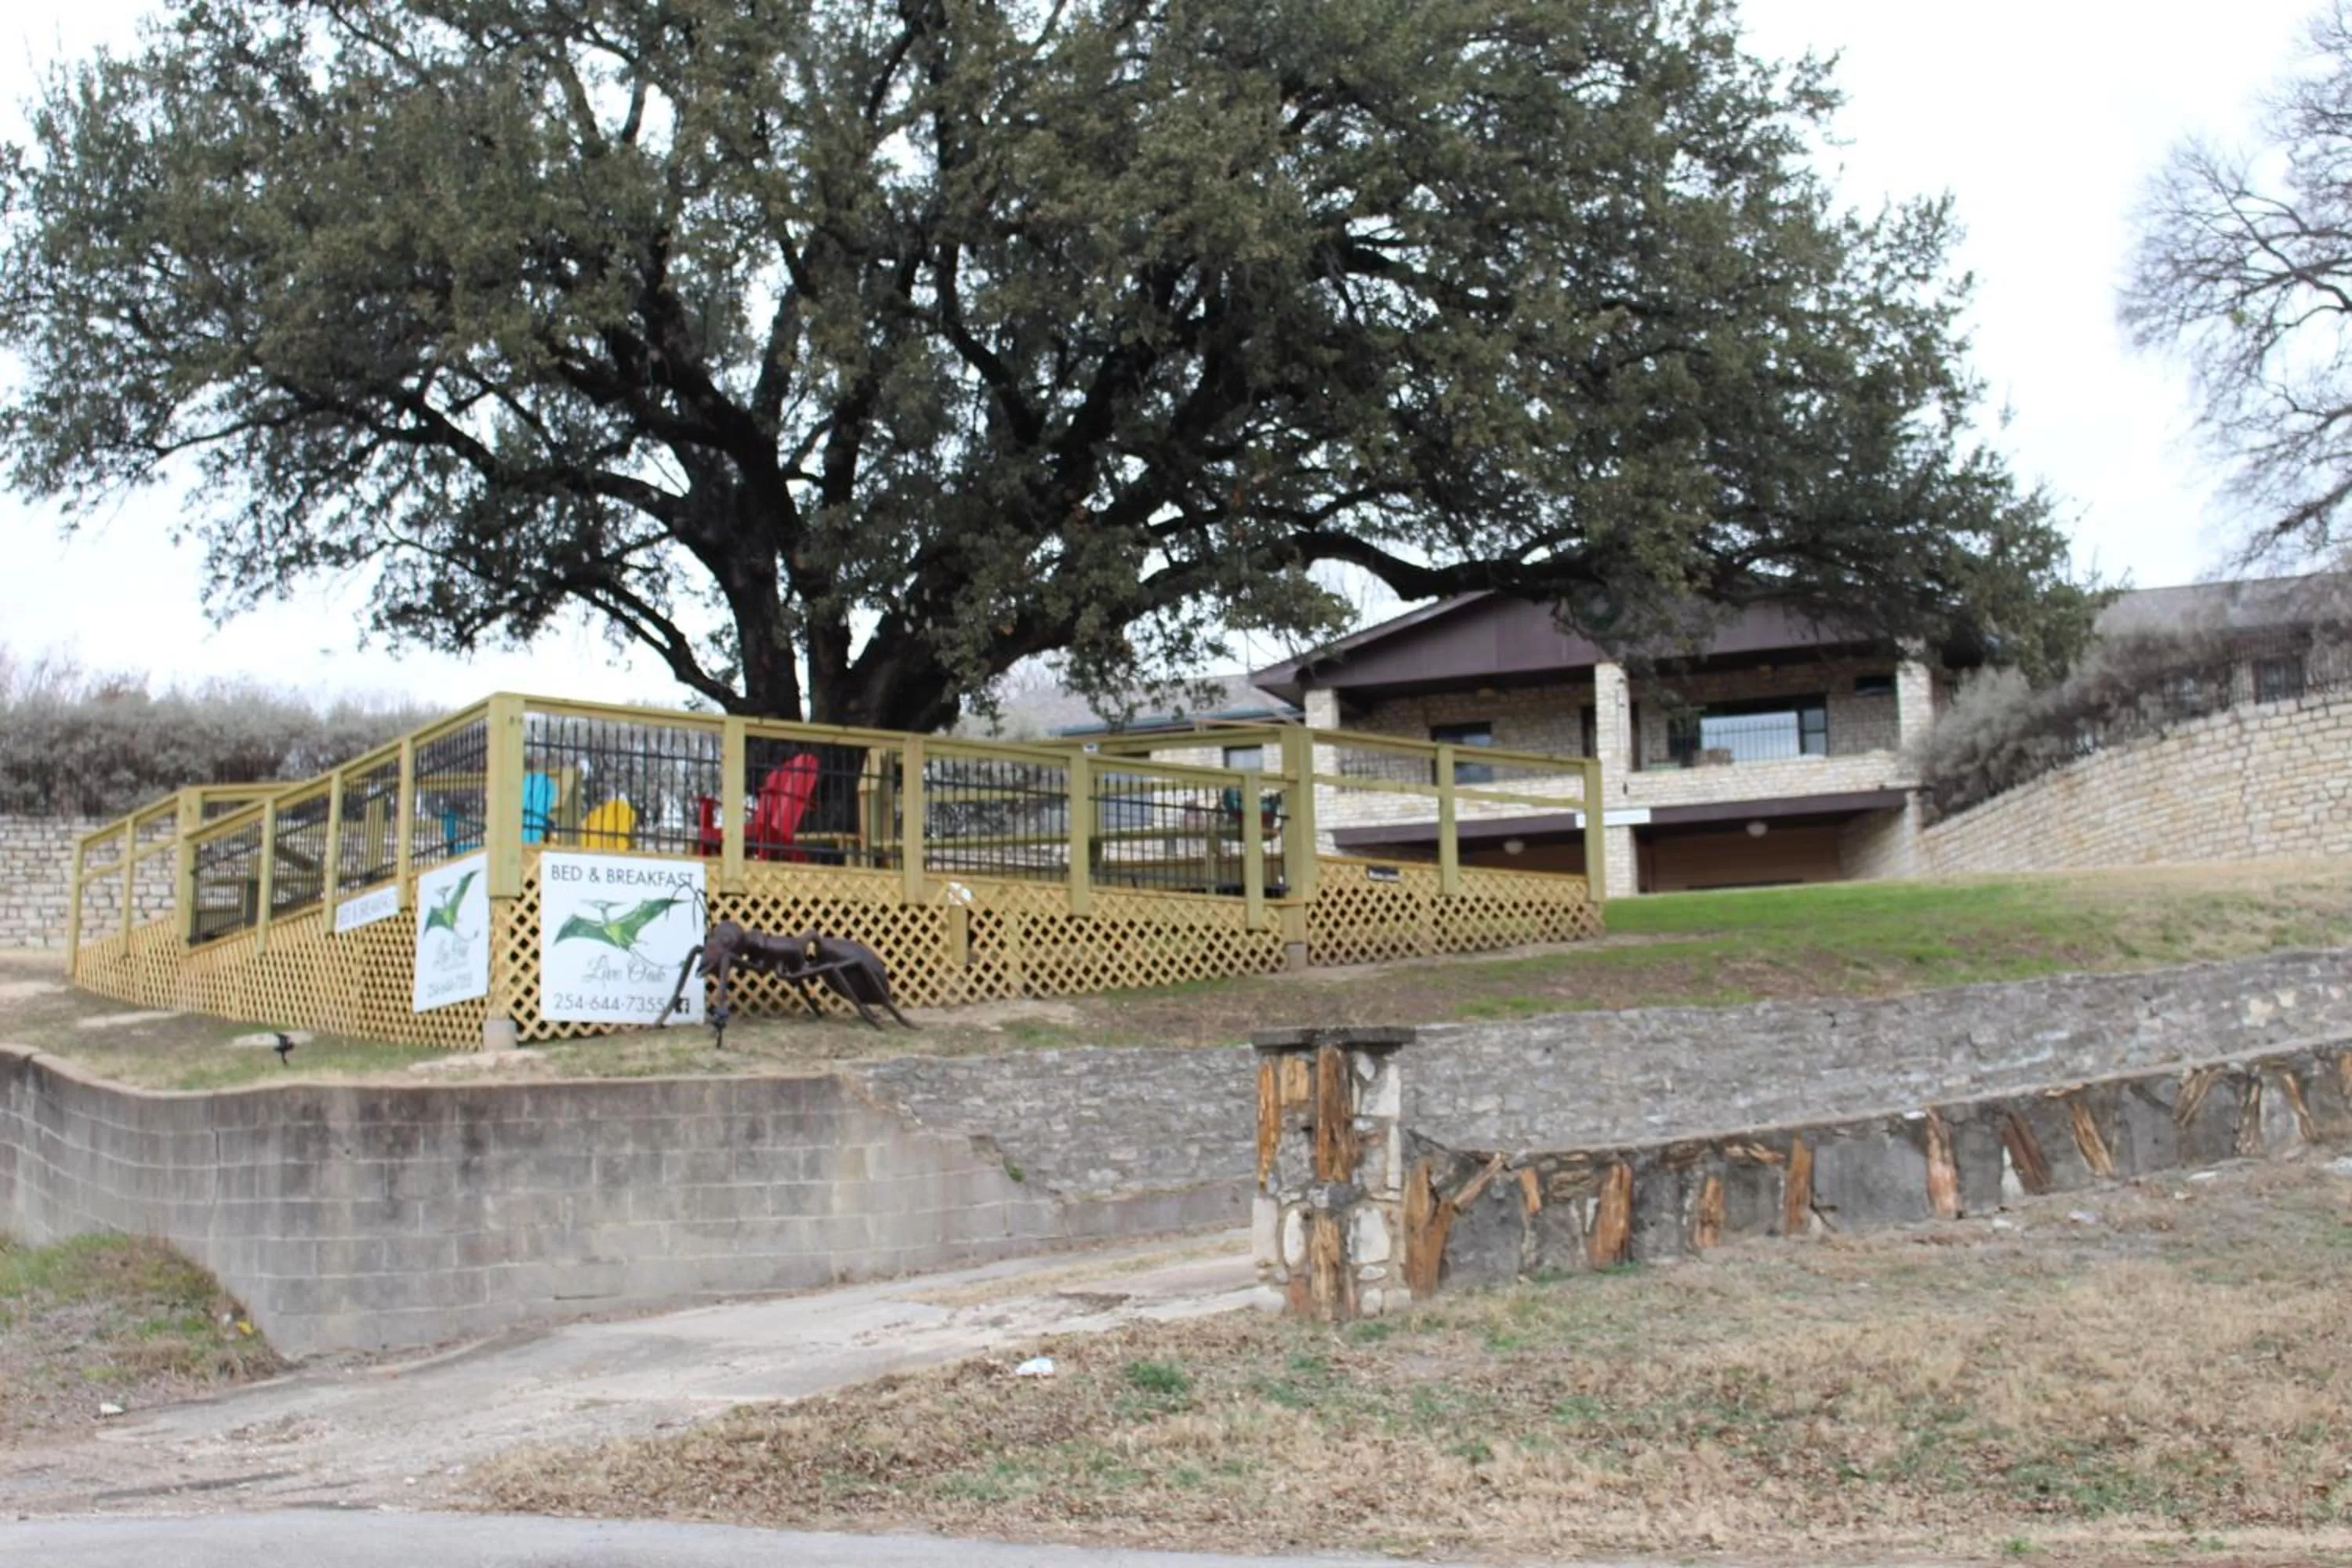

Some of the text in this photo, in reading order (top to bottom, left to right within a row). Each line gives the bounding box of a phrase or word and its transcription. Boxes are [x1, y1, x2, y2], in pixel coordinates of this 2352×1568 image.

[551, 864, 694, 887] BED & BREAKFAST
